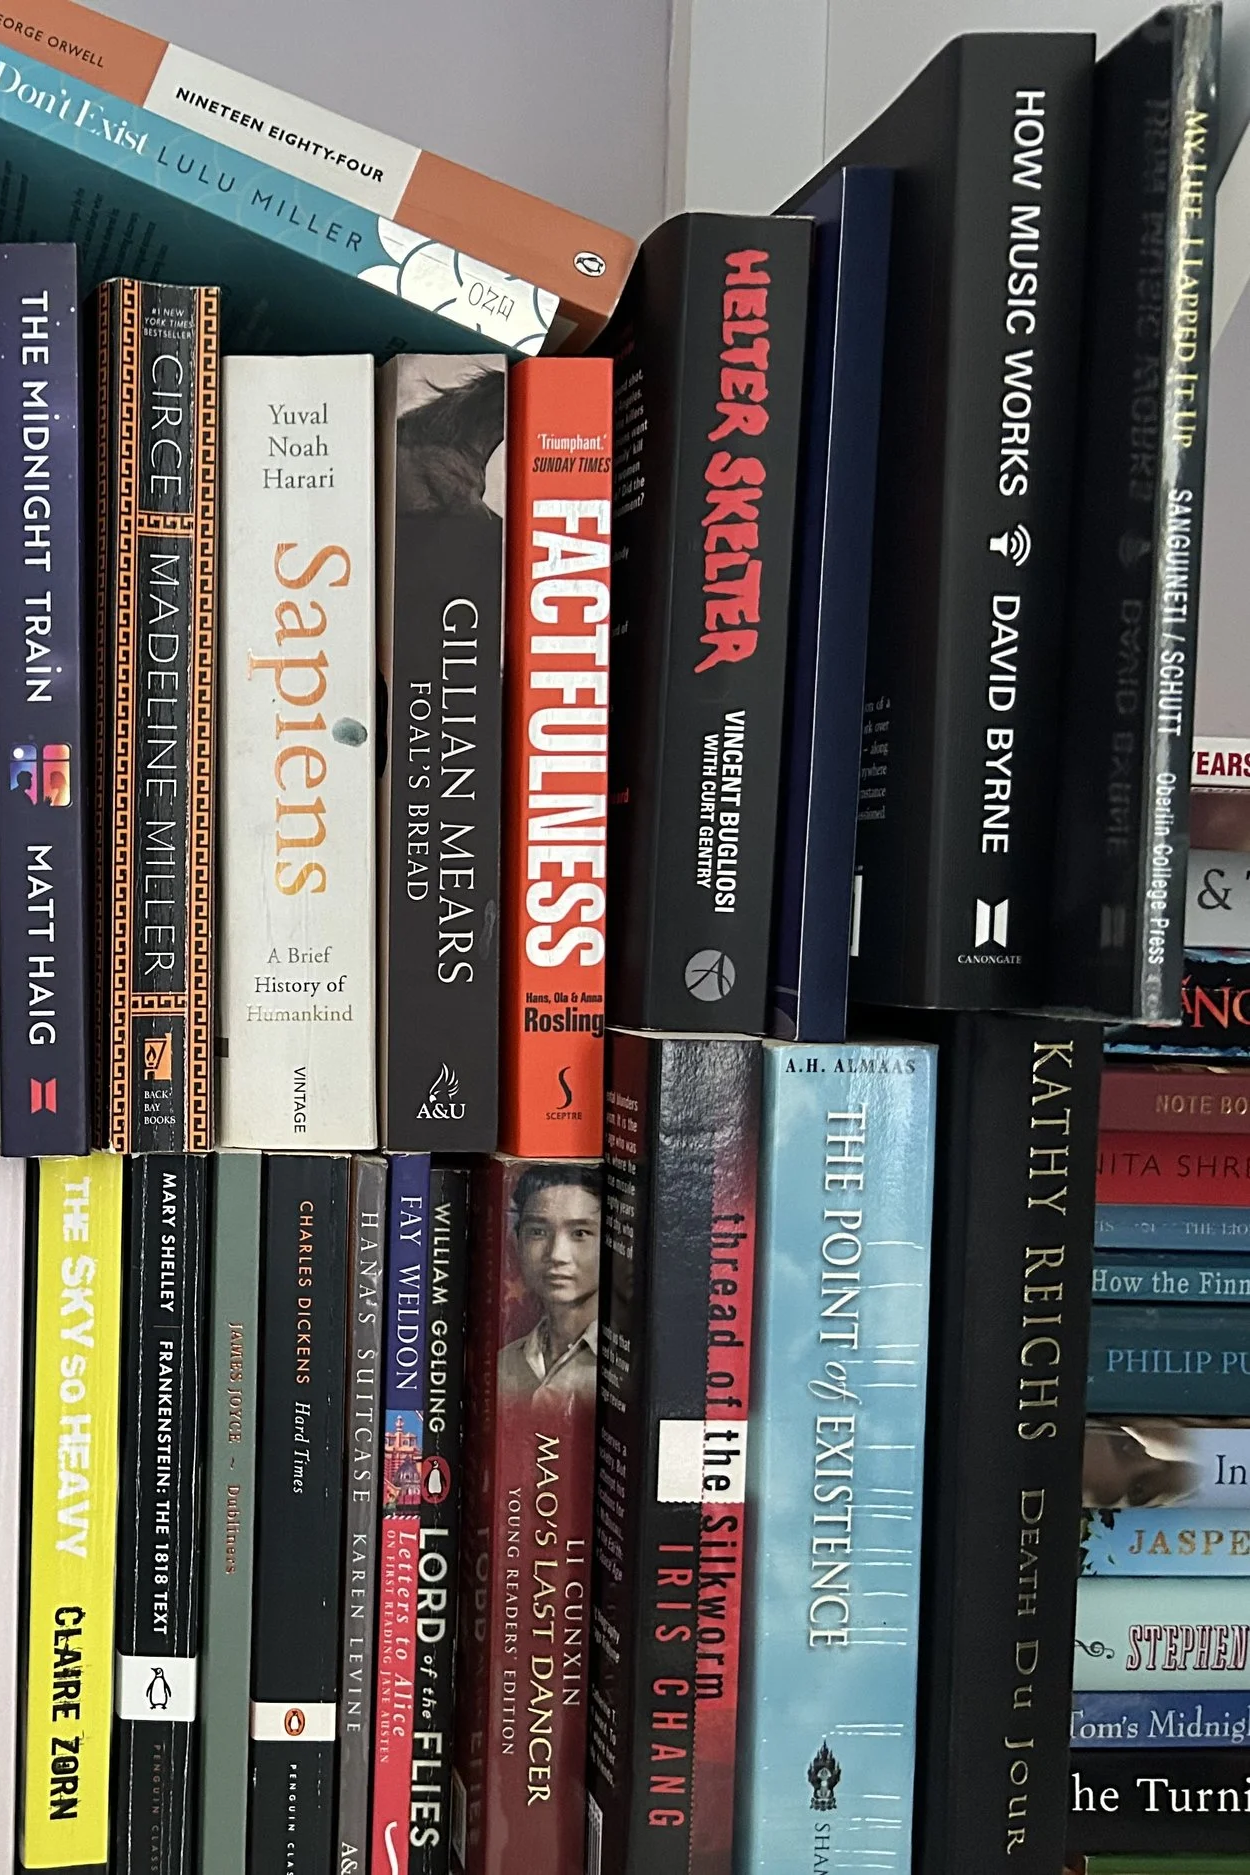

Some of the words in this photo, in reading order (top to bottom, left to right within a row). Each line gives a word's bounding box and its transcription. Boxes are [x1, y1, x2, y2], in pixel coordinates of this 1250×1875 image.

[47, 36, 105, 68] ORWELL
[176, 87, 264, 133] NINETEEN
[268, 126, 384, 182] EIGHTY-FOUR
[1011, 89, 1046, 190] HOW
[74, 99, 149, 155] Exist
[157, 147, 236, 193] LULU
[250, 189, 364, 253] MILLER
[1005, 204, 1041, 336] MUSIC
[707, 248, 772, 443] HELTER
[151, 354, 183, 496] CIRCE
[268, 402, 329, 426] Yuval
[268, 435, 329, 457] Noah
[998, 348, 1034, 497] WORKS
[263, 468, 335, 490] Harari
[532, 457, 577, 473] SUNDAY
[578, 457, 612, 473] TIMES
[694, 451, 767, 674] SKELTER
[988, 594, 1021, 712] DAVID
[248, 541, 352, 896] Sapiens
[408, 682, 432, 789] FOAL'S
[526, 500, 611, 967] FACTFULNESS
[702, 733, 719, 777] WITH
[720, 710, 746, 807] VINCENT
[981, 727, 1015, 855] BYRNE
[700, 780, 716, 822] CURT
[407, 804, 430, 901] BREAD
[696, 825, 714, 890] GENTRY
[715, 811, 741, 914] BUGLIOSI
[254, 975, 320, 997] History
[327, 975, 348, 993] of
[957, 954, 1022, 964] CANONGATE
[524, 1007, 605, 1038] Rosling
[144, 1090, 169, 1099] BACK
[144, 1103, 160, 1112] BAY
[293, 1066, 307, 1134] VINTAGE
[416, 1103, 466, 1120] A&U
[546, 1112, 582, 1121] SCEPTRE
[1027, 1040, 1074, 1217] KATHY
[824, 1102, 868, 1192] THE
[162, 1172, 177, 1228] MARY
[400, 1196, 423, 1246] FAY
[159, 1234, 175, 1313] SHELLEY
[298, 1200, 313, 1288] CHARLES
[432, 1203, 452, 1305] WILLIAM
[819, 1209, 864, 1351] POINT
[1151, 1270, 1189, 1294] the
[296, 1297, 311, 1384] DICKENS
[395, 1263, 421, 1391] WELDON
[1018, 1245, 1065, 1440] REICHS
[1108, 1349, 1212, 1373] PHILIP
[429, 1320, 448, 1434] GOLDING
[808, 1361, 863, 1405] of
[156, 1340, 173, 1494] FRANKENSTEIN:
[294, 1401, 310, 1443] Hard
[293, 1449, 310, 1494] Times
[156, 1500, 170, 1535] THE
[808, 1415, 855, 1650] EXISTENCE
[155, 1542, 169, 1585] 1818
[416, 1527, 449, 1644] LORD
[154, 1593, 168, 1635] TEXT
[1126, 1625, 1249, 1671] STEPHEN
[420, 1654, 438, 1681] of
[421, 1686, 438, 1720] the
[410, 1731, 444, 1849] FLIES
